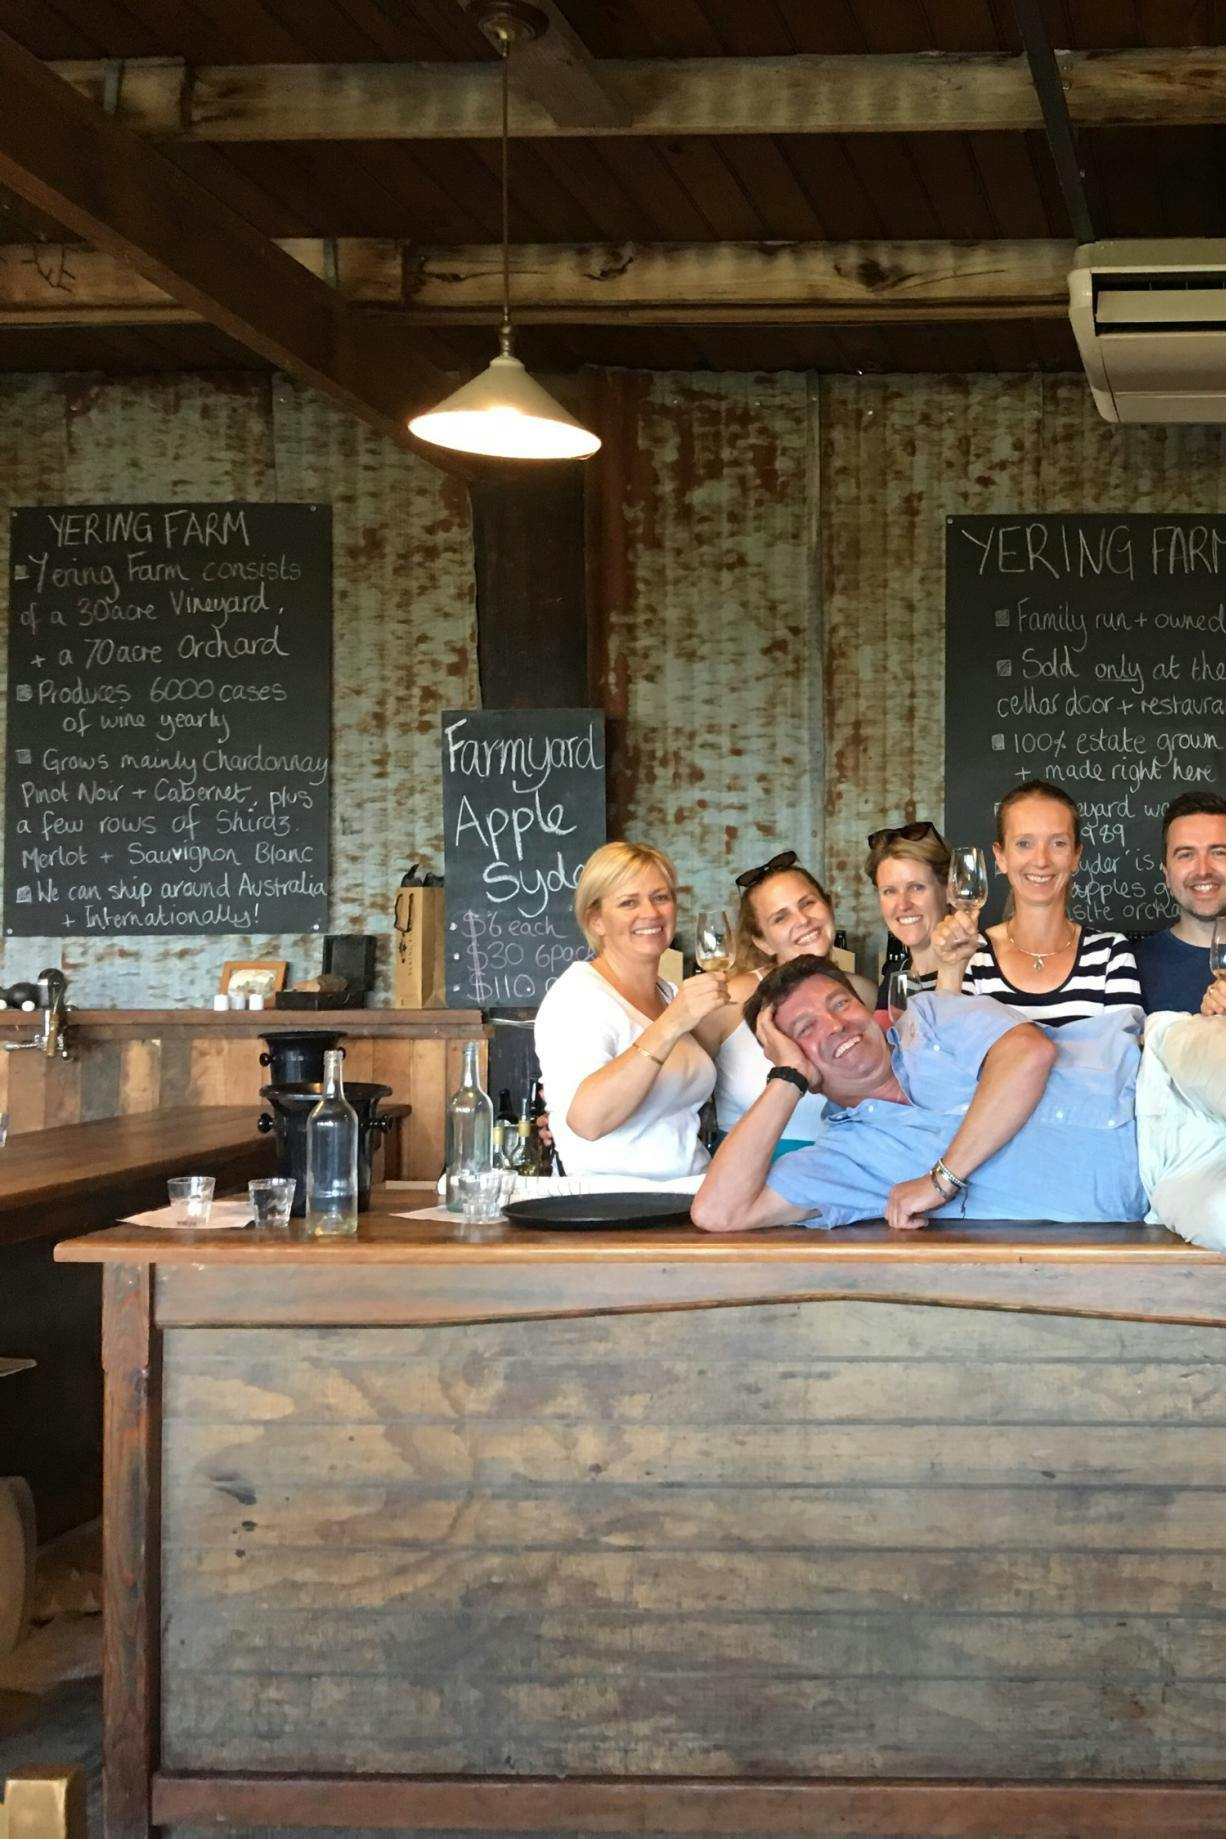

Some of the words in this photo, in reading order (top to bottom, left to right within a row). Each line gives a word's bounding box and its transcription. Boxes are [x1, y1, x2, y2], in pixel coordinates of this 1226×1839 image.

[48, 510, 151, 547] YERING
[165, 510, 250, 548] FARM
[961, 523, 1134, 581] YERING
[28, 552, 120, 603] Yering
[128, 552, 190, 582] Farm
[202, 555, 302, 581] consists
[20, 602, 37, 635] of
[51, 611, 66, 626] a
[1017, 597, 1088, 653] Family
[1095, 613, 1132, 632] run
[59, 648, 73, 666] a
[178, 624, 289, 660] Orchard
[1021, 645, 1080, 679] Sold
[1095, 653, 1145, 695] only
[1152, 654, 1181, 681] at
[38, 677, 131, 705] Produces
[151, 677, 213, 704] 6000
[219, 683, 287, 703] cases
[997, 686, 1061, 718] cellar
[1065, 687, 1112, 717] door
[63, 708, 91, 737] of
[101, 707, 146, 728] wine
[156, 708, 230, 743] yearly
[43, 749, 109, 775] Grows
[120, 749, 197, 785] mainly
[203, 745, 328, 785] Chardonnay
[444, 717, 605, 793] Farmyard
[1013, 729, 1068, 758] 100%
[1076, 727, 1147, 755] estate
[1156, 729, 1224, 767] grown
[1045, 763, 1106, 782] made
[1111, 757, 1162, 793] right
[1172, 758, 1216, 783] here
[78, 780, 126, 802] Noir
[269, 787, 313, 814] plus
[1077, 794, 1136, 829] eyard
[17, 821, 31, 834] a
[43, 811, 84, 841] few
[100, 816, 157, 834] rows
[172, 803, 200, 840] of
[455, 788, 577, 861] Apple
[1080, 823, 1126, 847] 989
[22, 849, 88, 873] Merlot
[128, 841, 241, 873] Sauvignon
[255, 842, 313, 864] Blanc
[38, 882, 59, 901] We
[68, 886, 101, 901] can
[108, 876, 152, 907] ship
[161, 873, 229, 899] around
[238, 871, 327, 898] Australia
[482, 851, 584, 919] Syde
[85, 904, 260, 930] Internationally!
[508, 915, 568, 939] each
[1122, 900, 1180, 921] orcha
